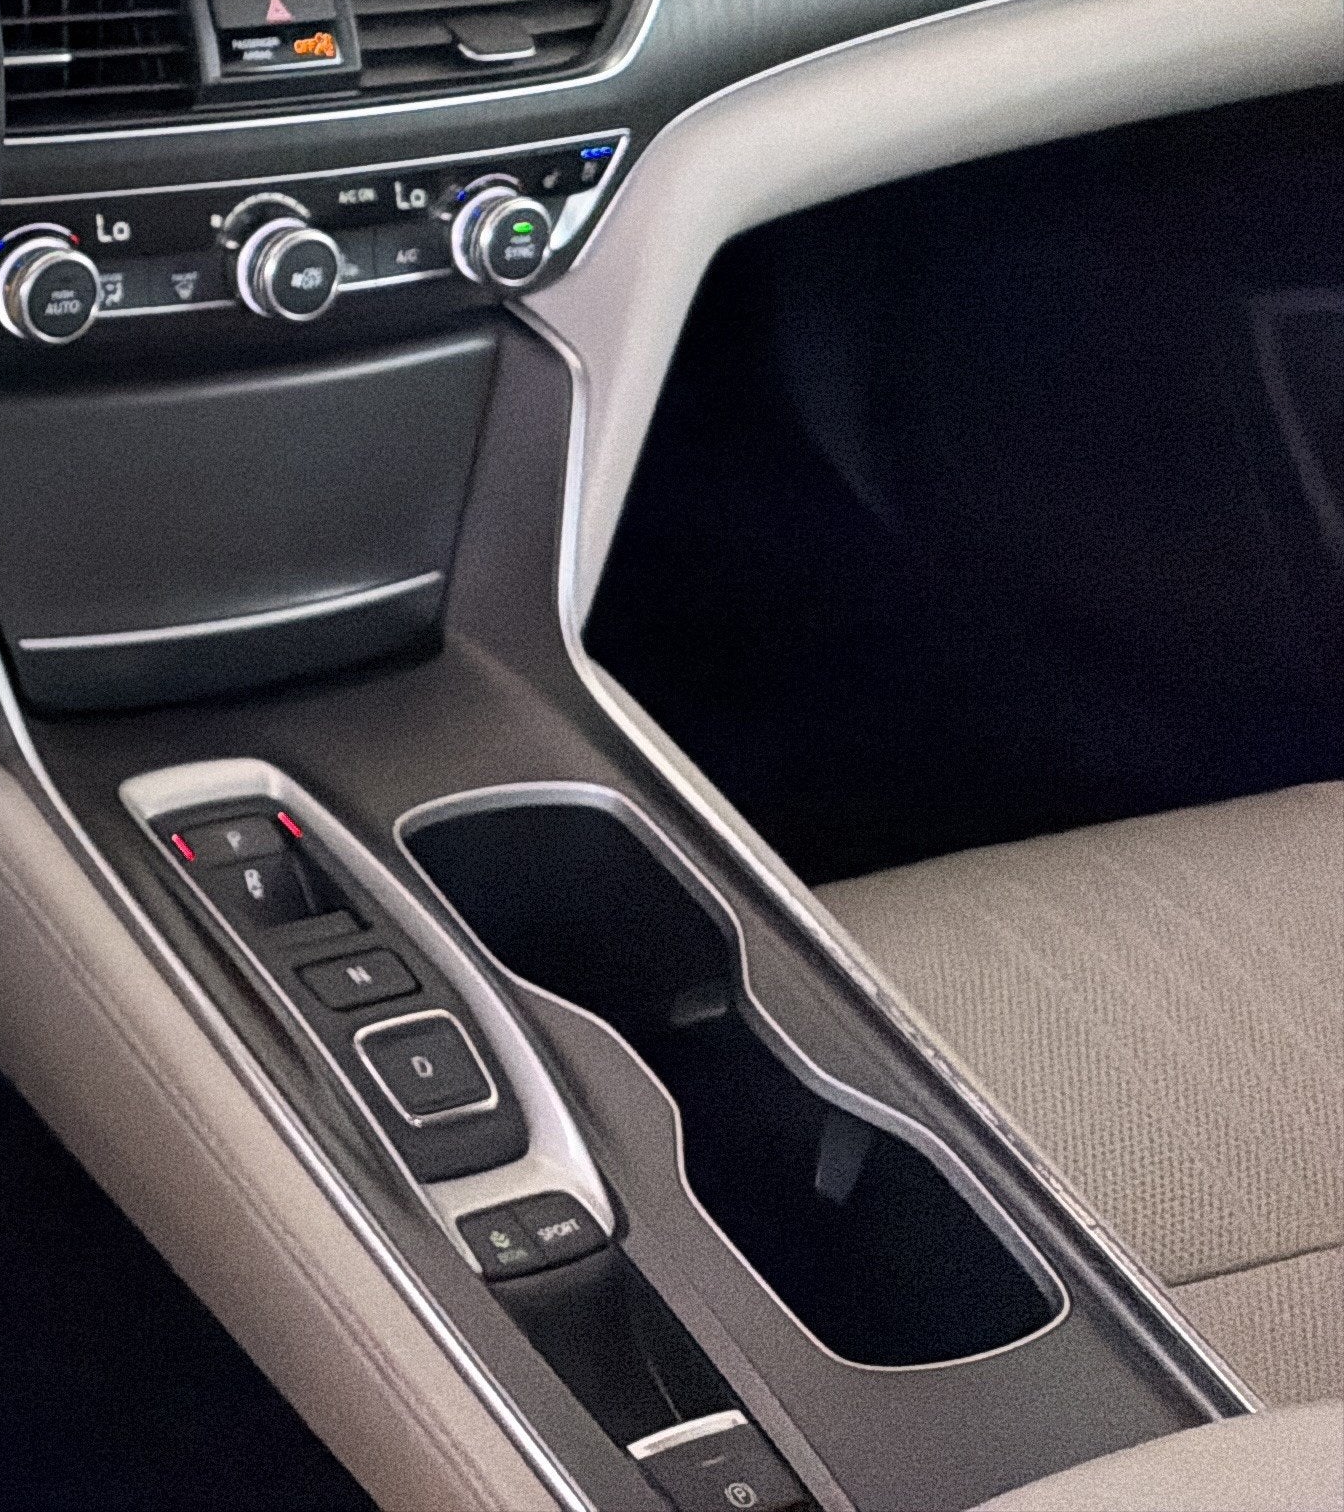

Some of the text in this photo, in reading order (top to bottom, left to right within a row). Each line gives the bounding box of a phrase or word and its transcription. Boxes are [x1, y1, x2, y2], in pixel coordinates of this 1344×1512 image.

[95, 213, 131, 243] Lo
[44, 299, 82, 315] AUTO
[226, 830, 242, 852] P
[346, 966, 372, 984] N
[411, 1055, 433, 1078] D
[536, 1218, 581, 1242] SPORT
